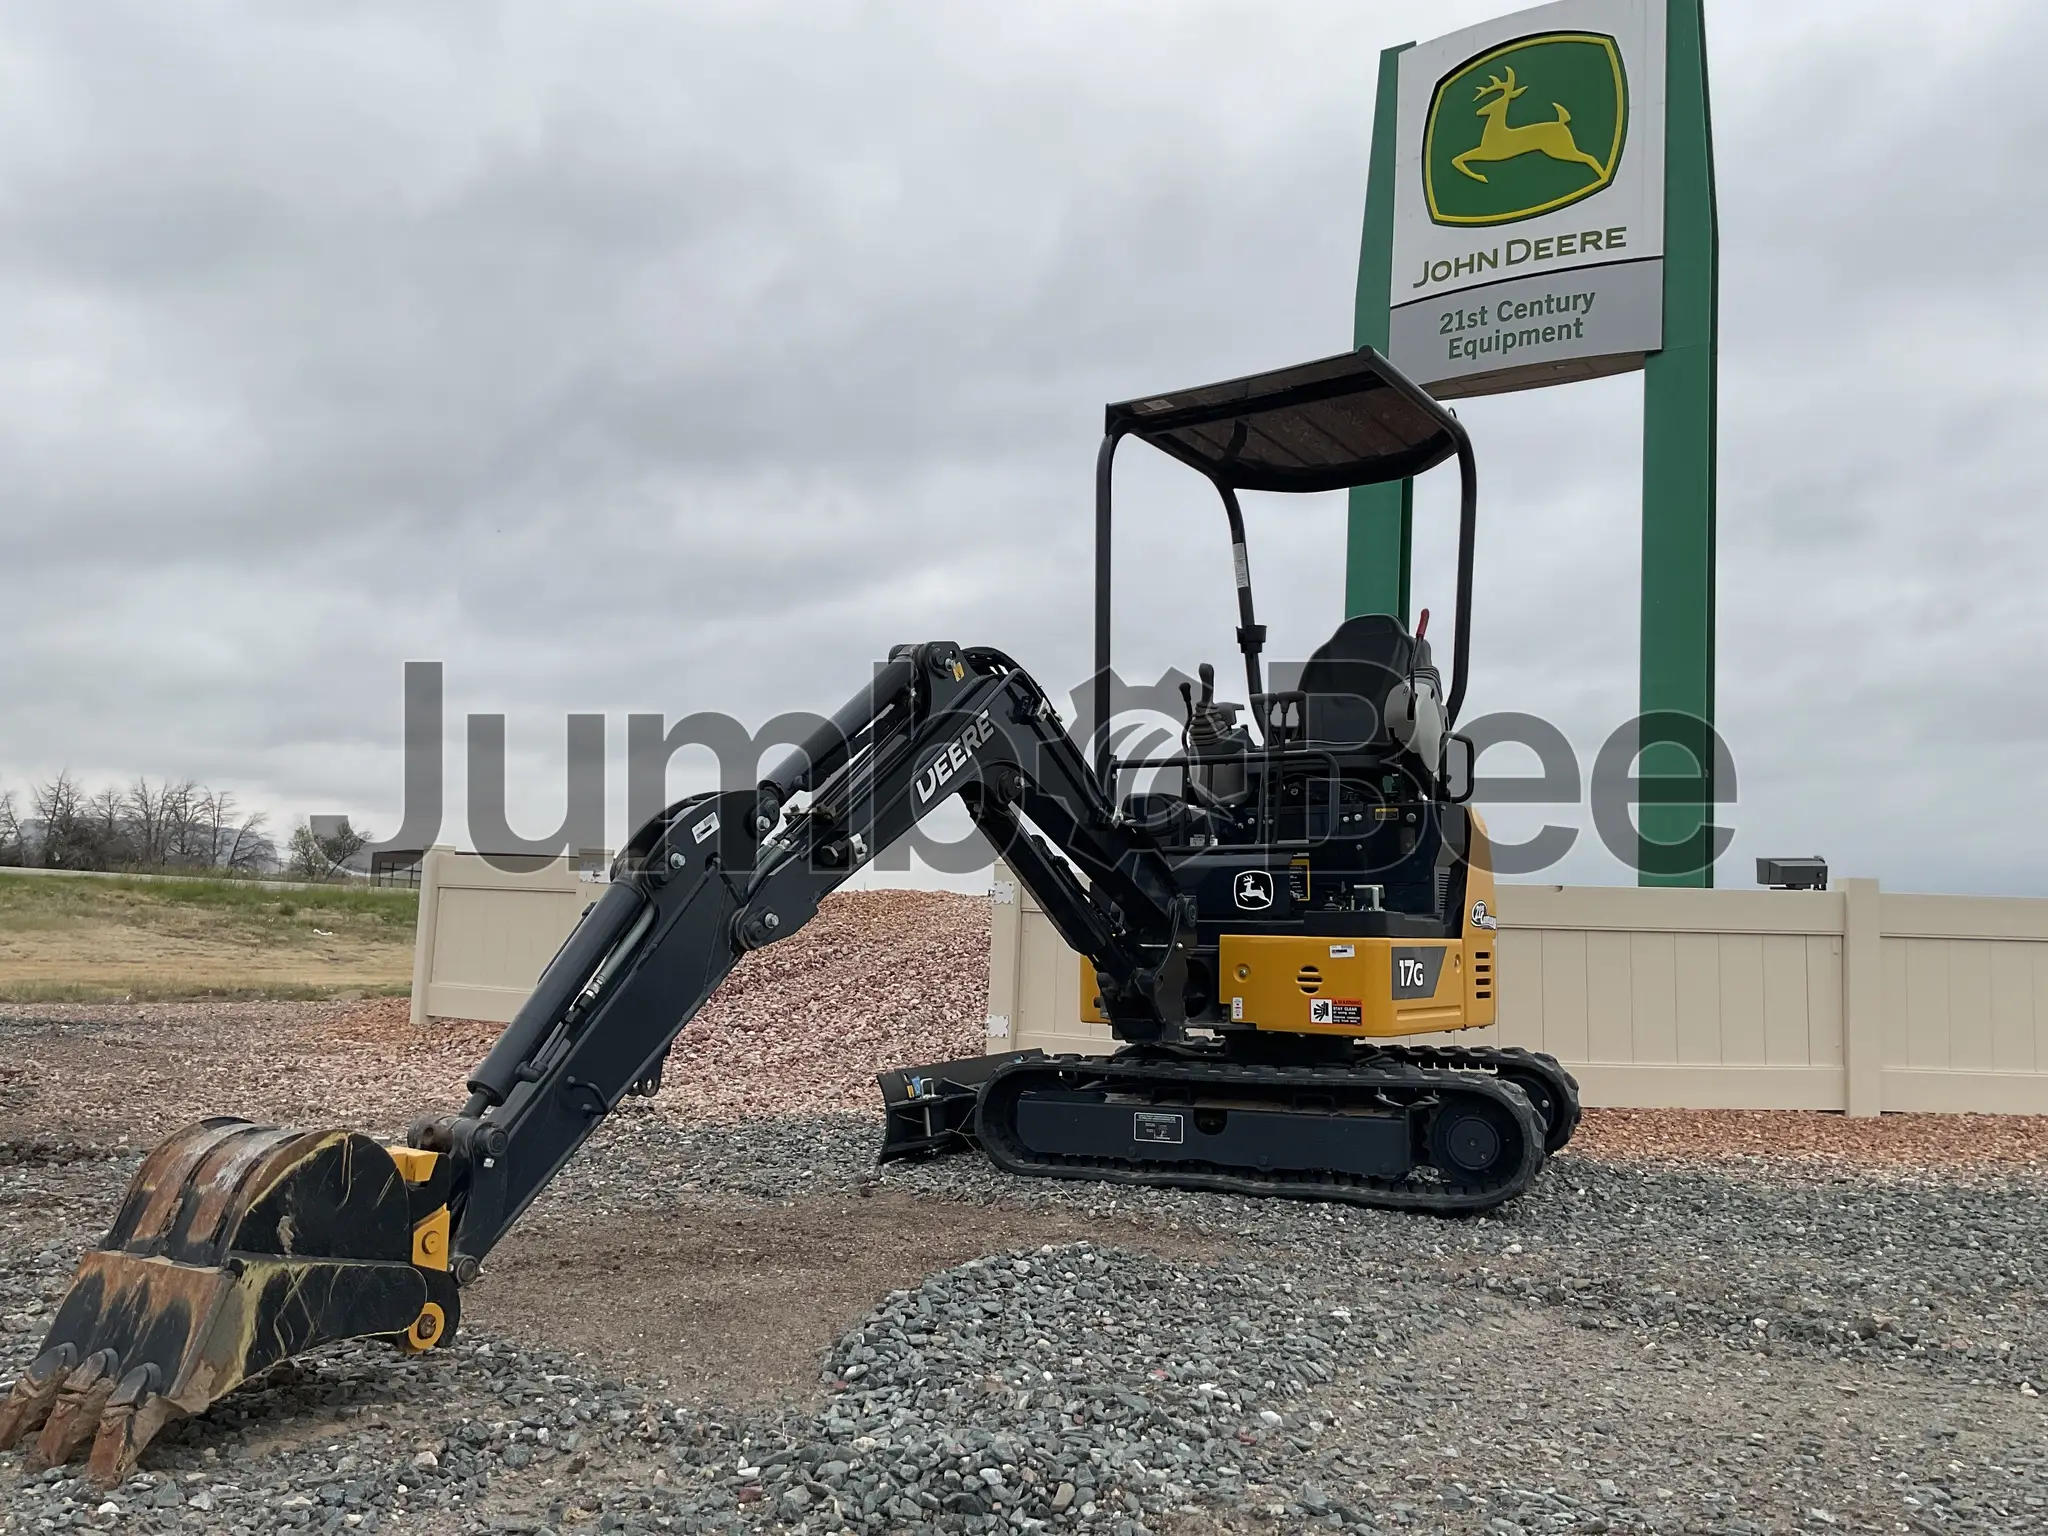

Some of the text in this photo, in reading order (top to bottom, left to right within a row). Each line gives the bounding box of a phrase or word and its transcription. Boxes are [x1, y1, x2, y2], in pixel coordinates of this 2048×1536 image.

[1413, 227, 1627, 288] JOHN DEERE
[1440, 292, 1595, 335] 21st Century
[1448, 317, 1584, 360] Equipment
[915, 709, 995, 804] DEERE
[1399, 959, 1424, 987] 17G
